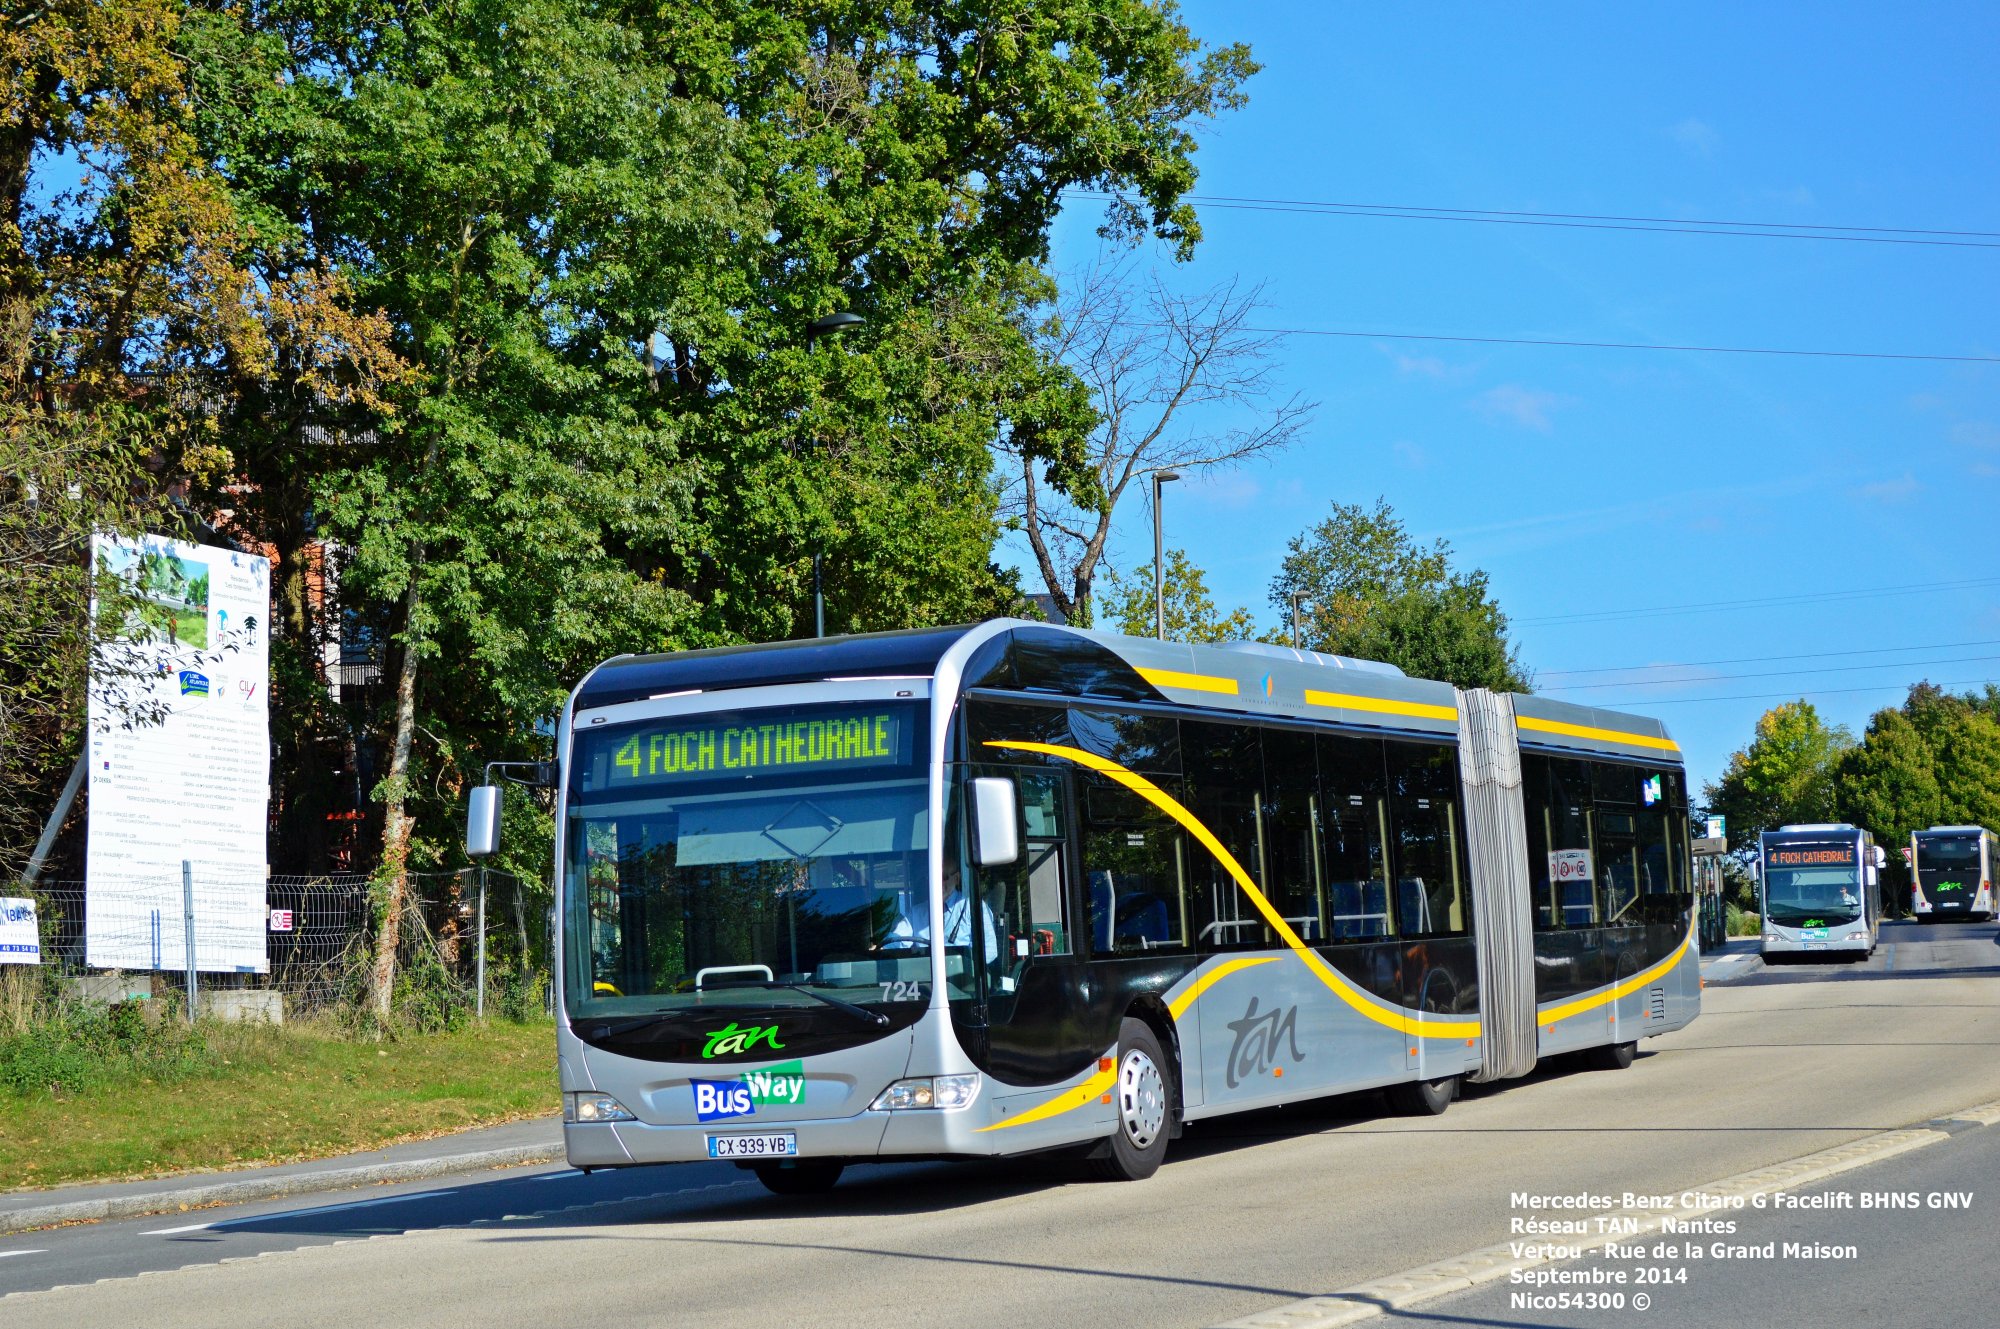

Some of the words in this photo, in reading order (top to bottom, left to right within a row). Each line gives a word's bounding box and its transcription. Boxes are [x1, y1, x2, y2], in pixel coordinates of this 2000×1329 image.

[239, 680, 250, 692] CIL
[615, 733, 641, 778] 4
[649, 730, 715, 774] FOCH
[723, 715, 890, 768] CATHEDRALE
[1770, 852, 1778, 864] 4
[1780, 852, 1801, 864] FOCH
[1803, 850, 1852, 863] CATHEDRALE
[1937, 881, 1964, 892] tan
[1801, 932, 1815, 940] Bus
[879, 980, 921, 1002] 724
[702, 1022, 786, 1059] tan
[1226, 996, 1306, 1089] tan
[696, 1084, 751, 1115] Bus
[745, 1071, 804, 1104] Way
